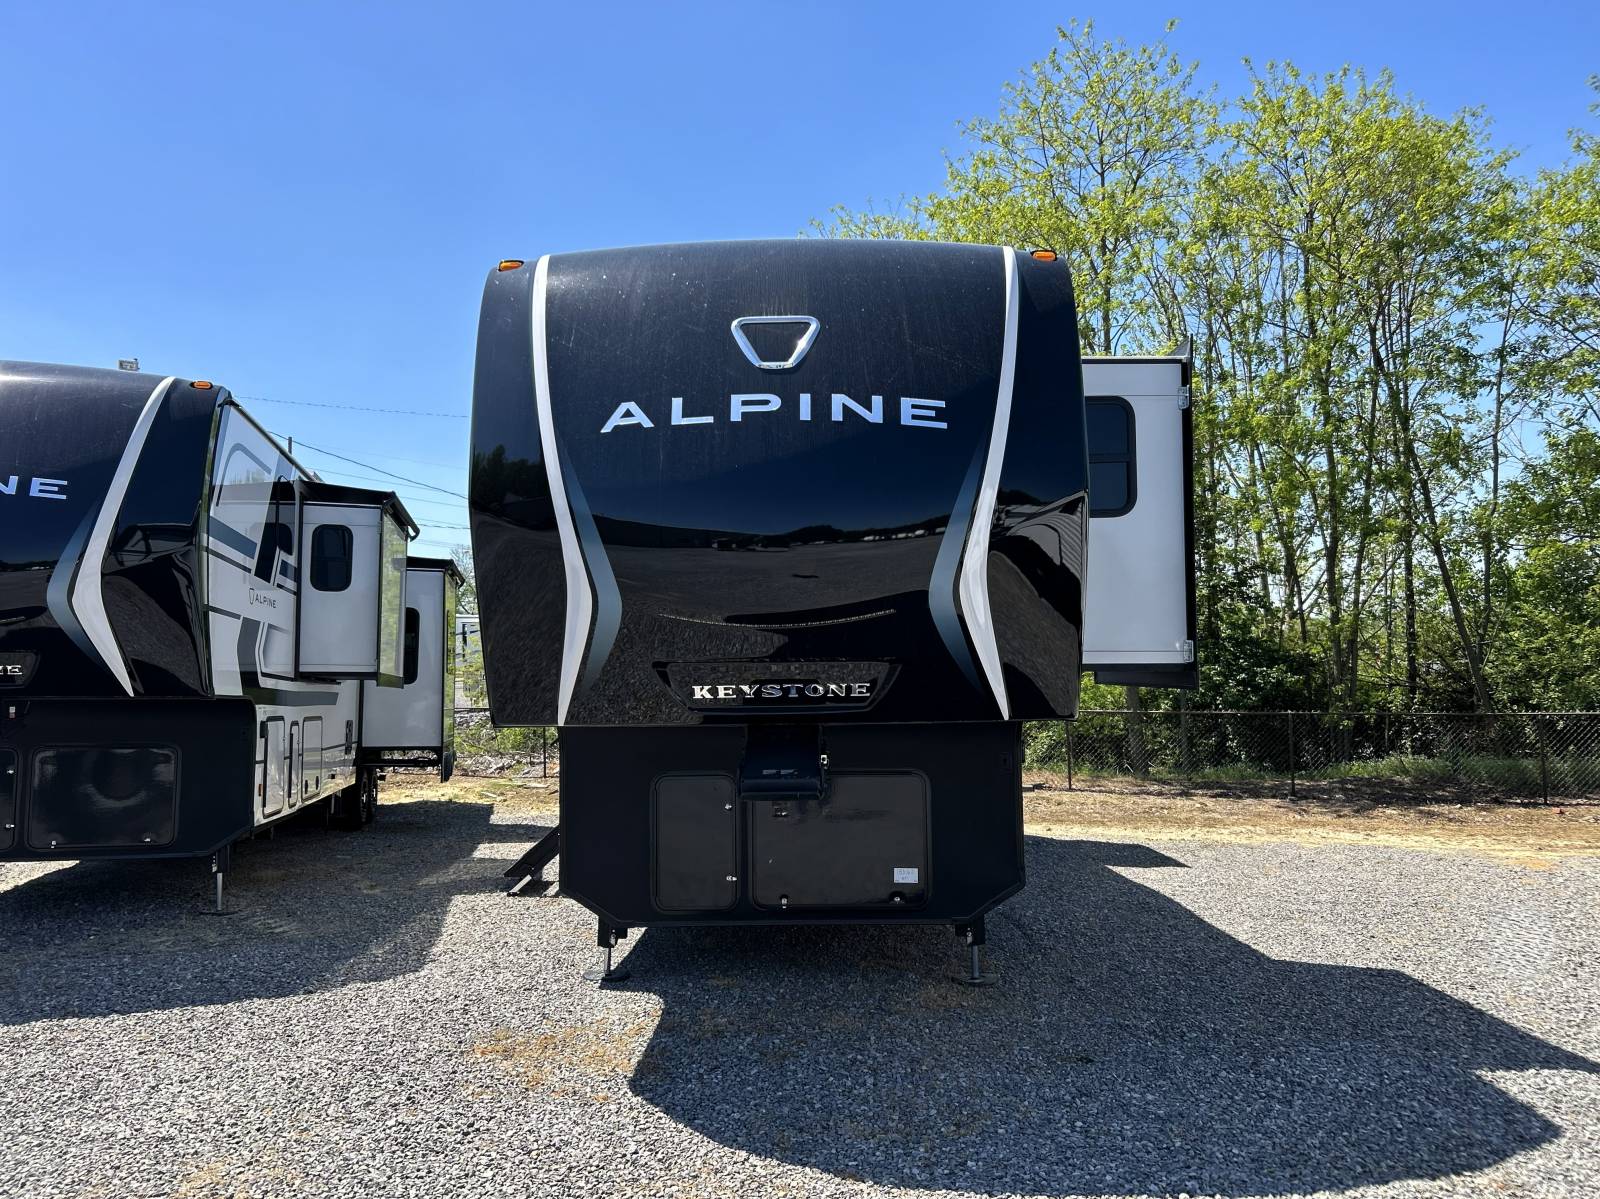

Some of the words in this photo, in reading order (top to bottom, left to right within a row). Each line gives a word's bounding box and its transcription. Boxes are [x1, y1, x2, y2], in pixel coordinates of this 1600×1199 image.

[600, 393, 948, 433] ALPINE
[255, 593, 277, 609] ALPINE
[691, 683, 871, 699] KEYSTONE
